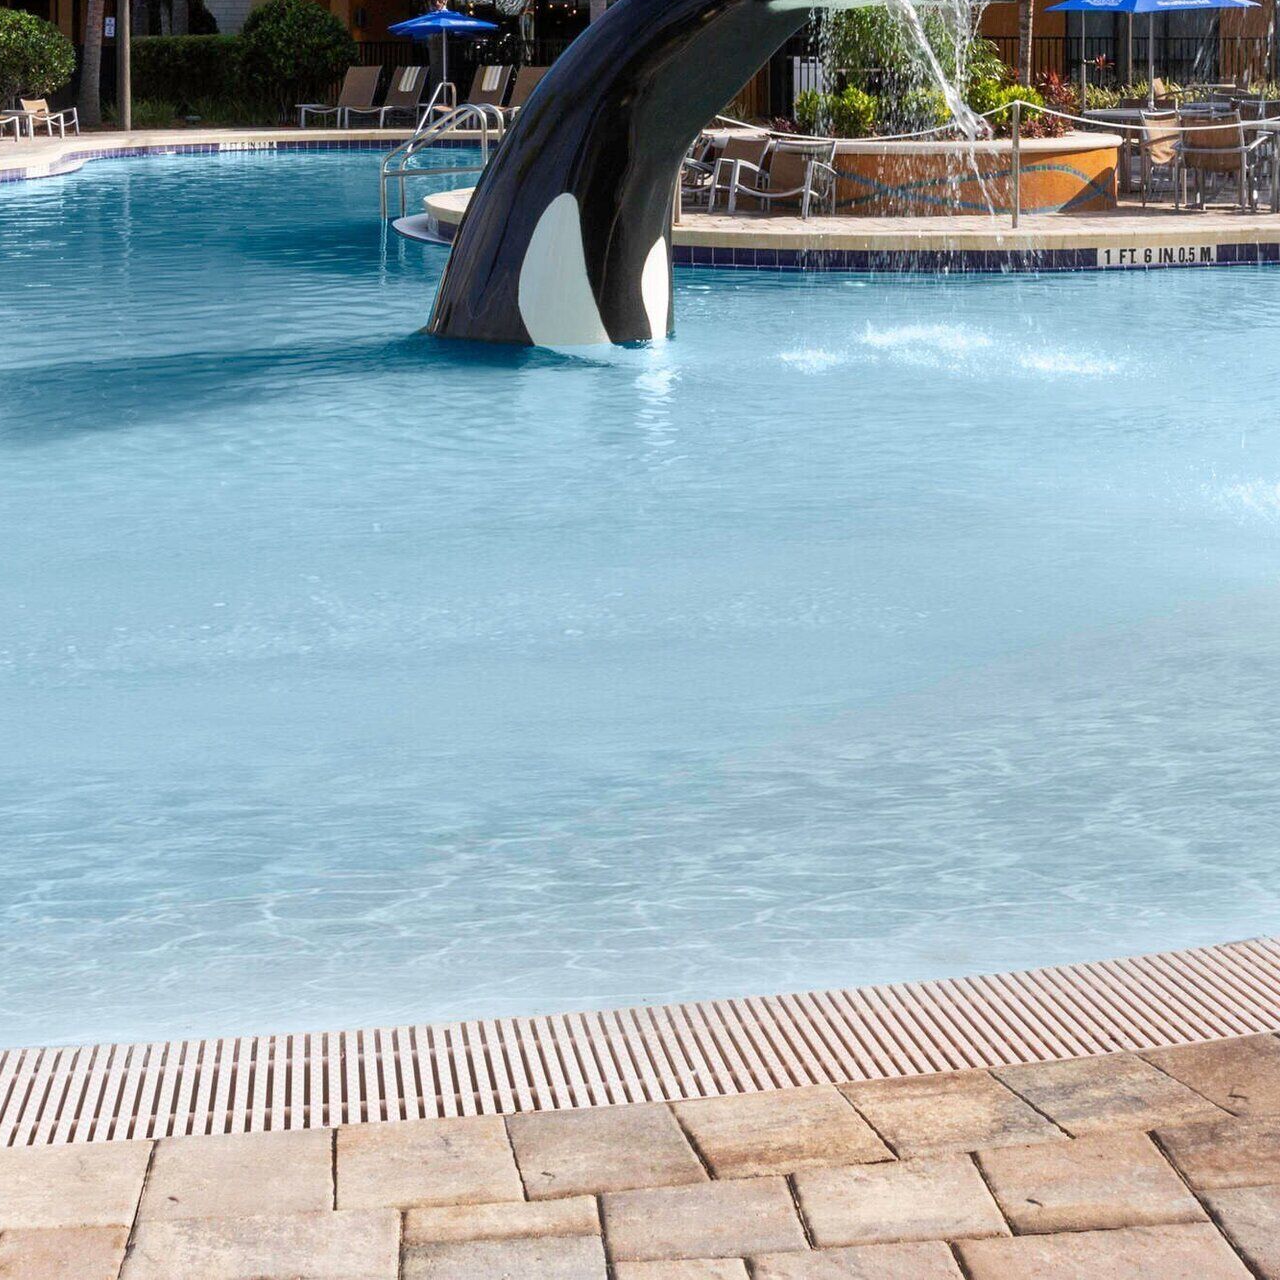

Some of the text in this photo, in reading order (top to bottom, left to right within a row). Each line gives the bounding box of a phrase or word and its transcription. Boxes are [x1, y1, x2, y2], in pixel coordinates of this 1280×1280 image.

[1104, 249, 1111, 265] 1
[1120, 248, 1137, 264] FT.
[1144, 248, 1152, 263] 6
[1158, 247, 1176, 263] IN.
[1178, 246, 1195, 263] 0.5
